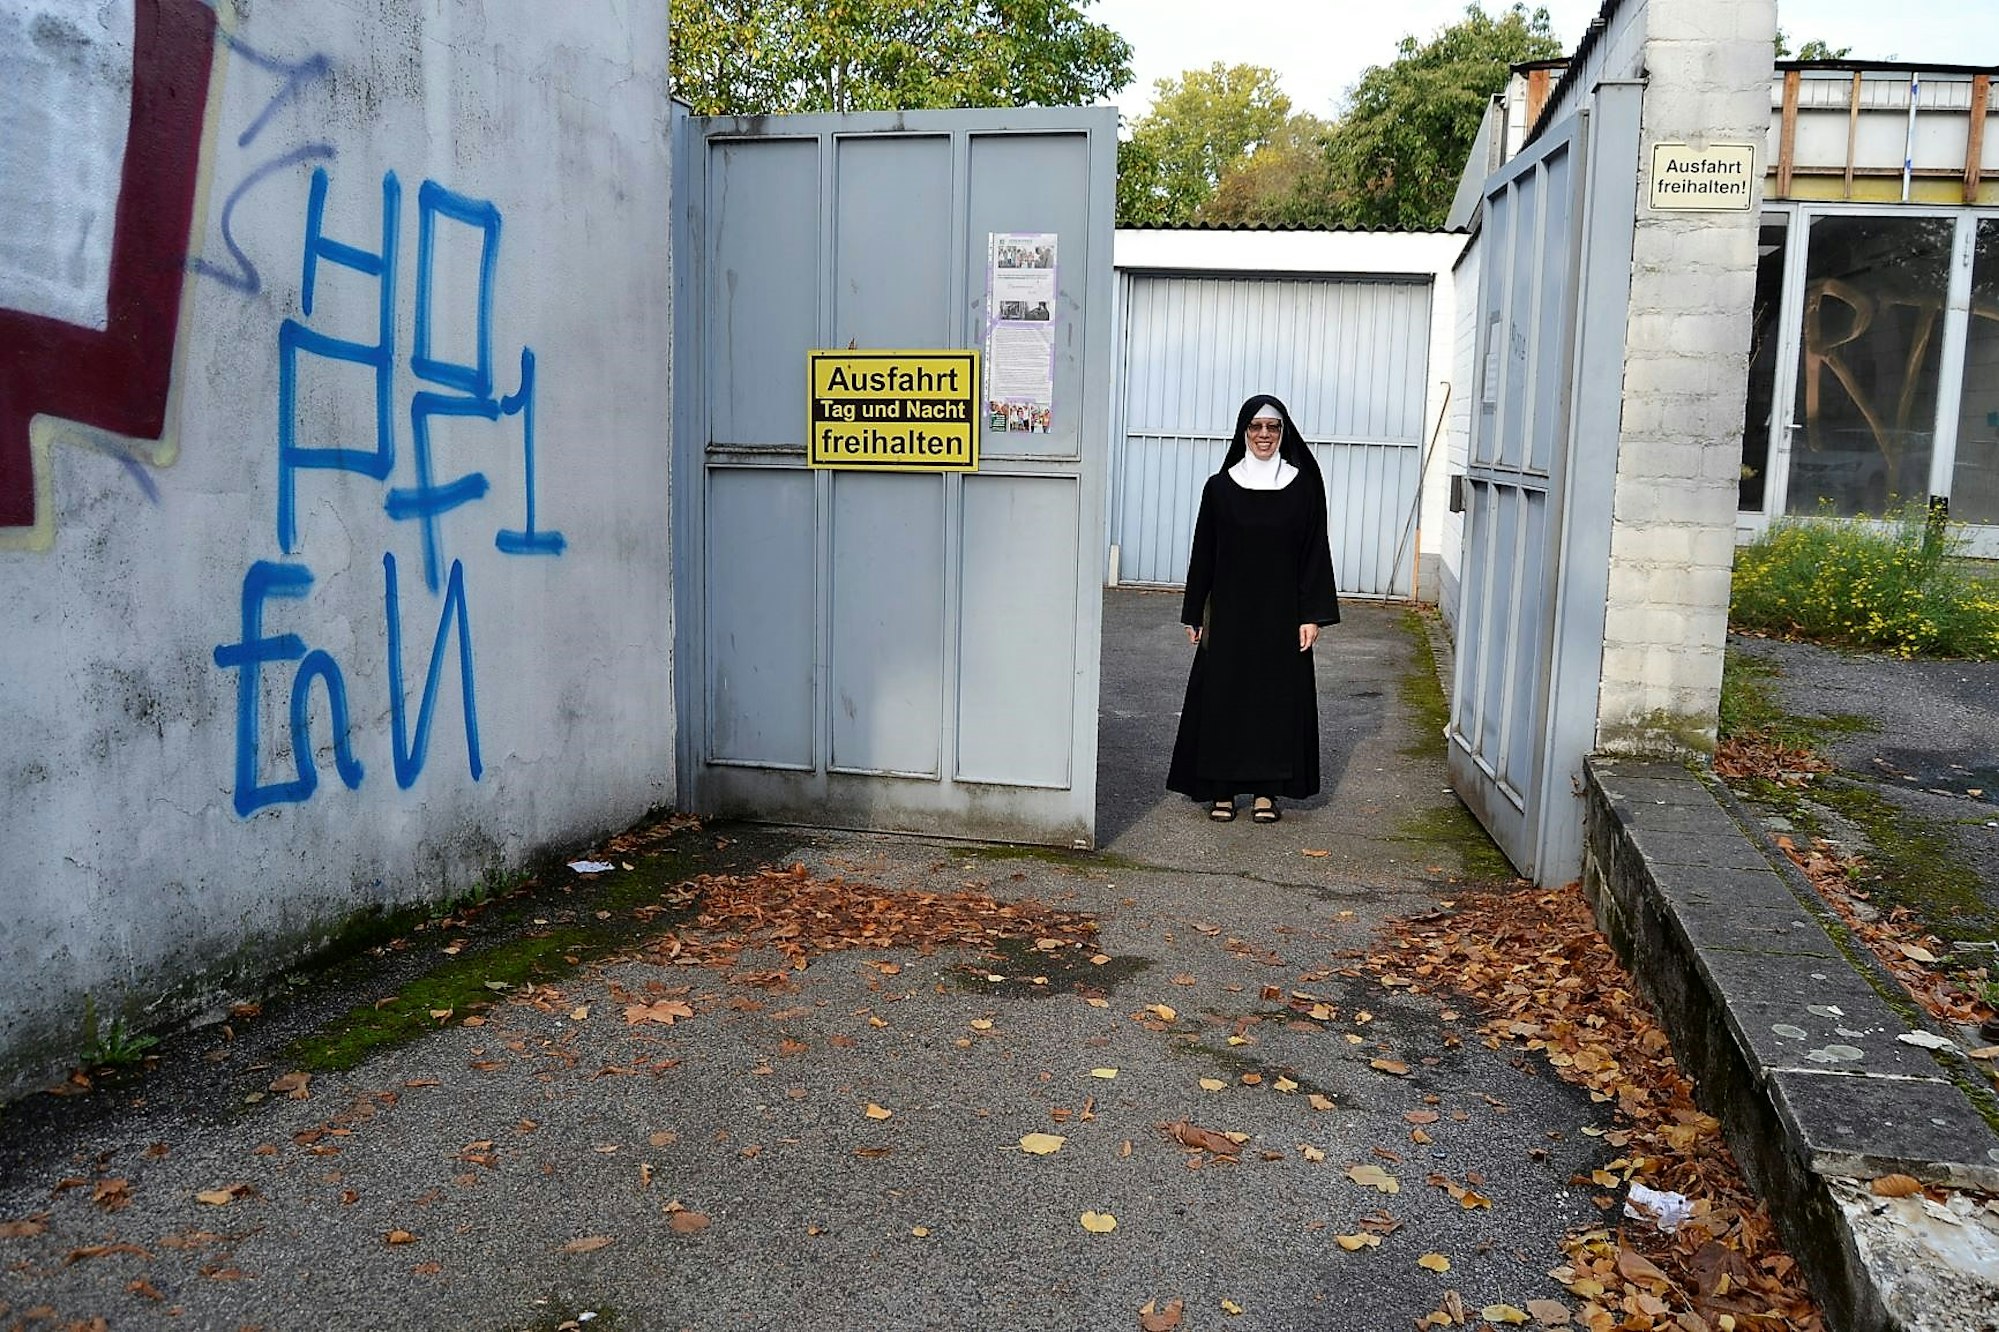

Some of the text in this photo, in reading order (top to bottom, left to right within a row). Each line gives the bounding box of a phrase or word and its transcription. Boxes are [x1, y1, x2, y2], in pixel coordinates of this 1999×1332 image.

[1666, 159, 1742, 174] Ausfahrt
[1658, 179, 1746, 194] freihalten!
[827, 366, 958, 392] Ausfahrt
[820, 400, 965, 422] Tag und Nacht
[822, 429, 962, 455] freihalten
